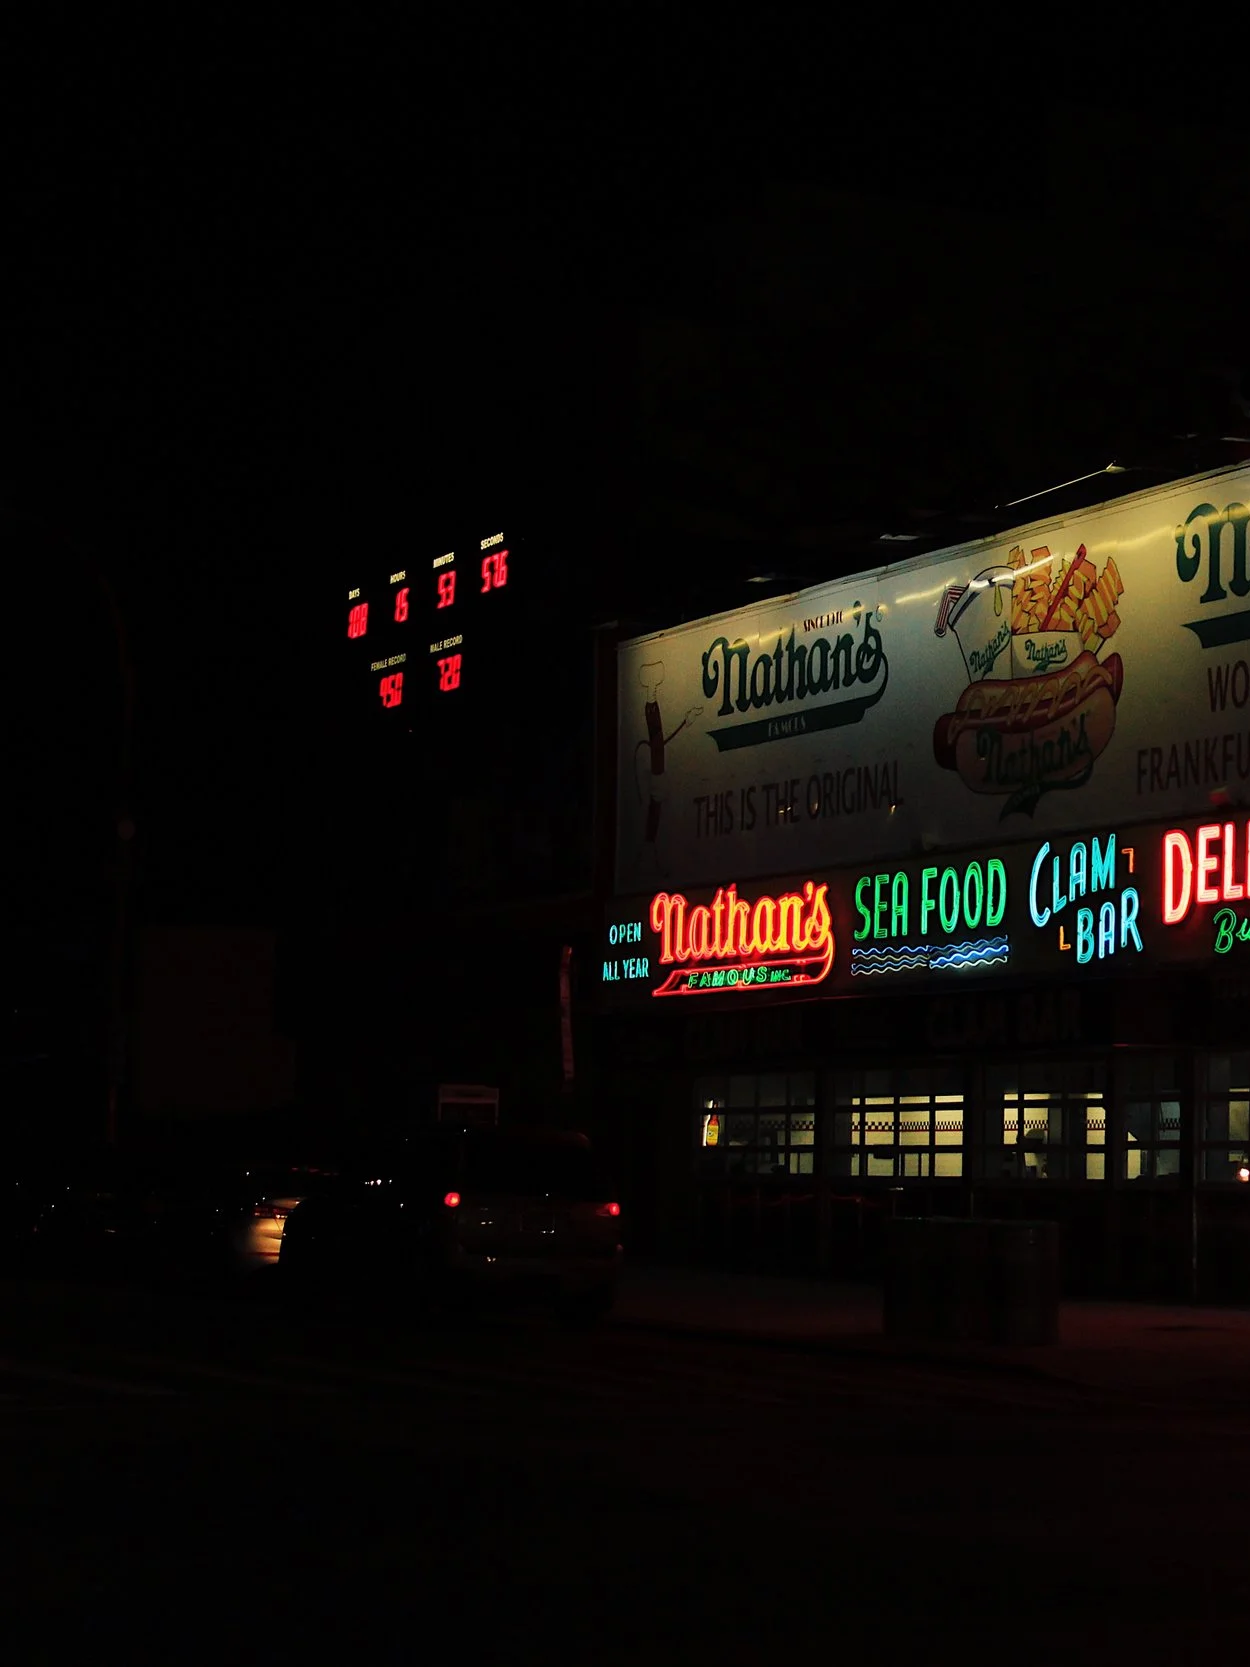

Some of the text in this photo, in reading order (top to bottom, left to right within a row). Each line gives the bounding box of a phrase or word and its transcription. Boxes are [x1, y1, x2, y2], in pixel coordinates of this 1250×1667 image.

[480, 532, 504, 550] SECONDS
[702, 601, 883, 717] Nathan's
[694, 760, 904, 838] THIS IS THE ORIGINAL
[854, 858, 1007, 941] SEA FOOD
[1029, 833, 1116, 928] CLAM
[609, 922, 641, 945] OPEN
[650, 881, 832, 964] Nathan's
[1076, 887, 1144, 964] BAR
[603, 957, 649, 981] ALL YEAR
[687, 966, 768, 988] FAMOUS
